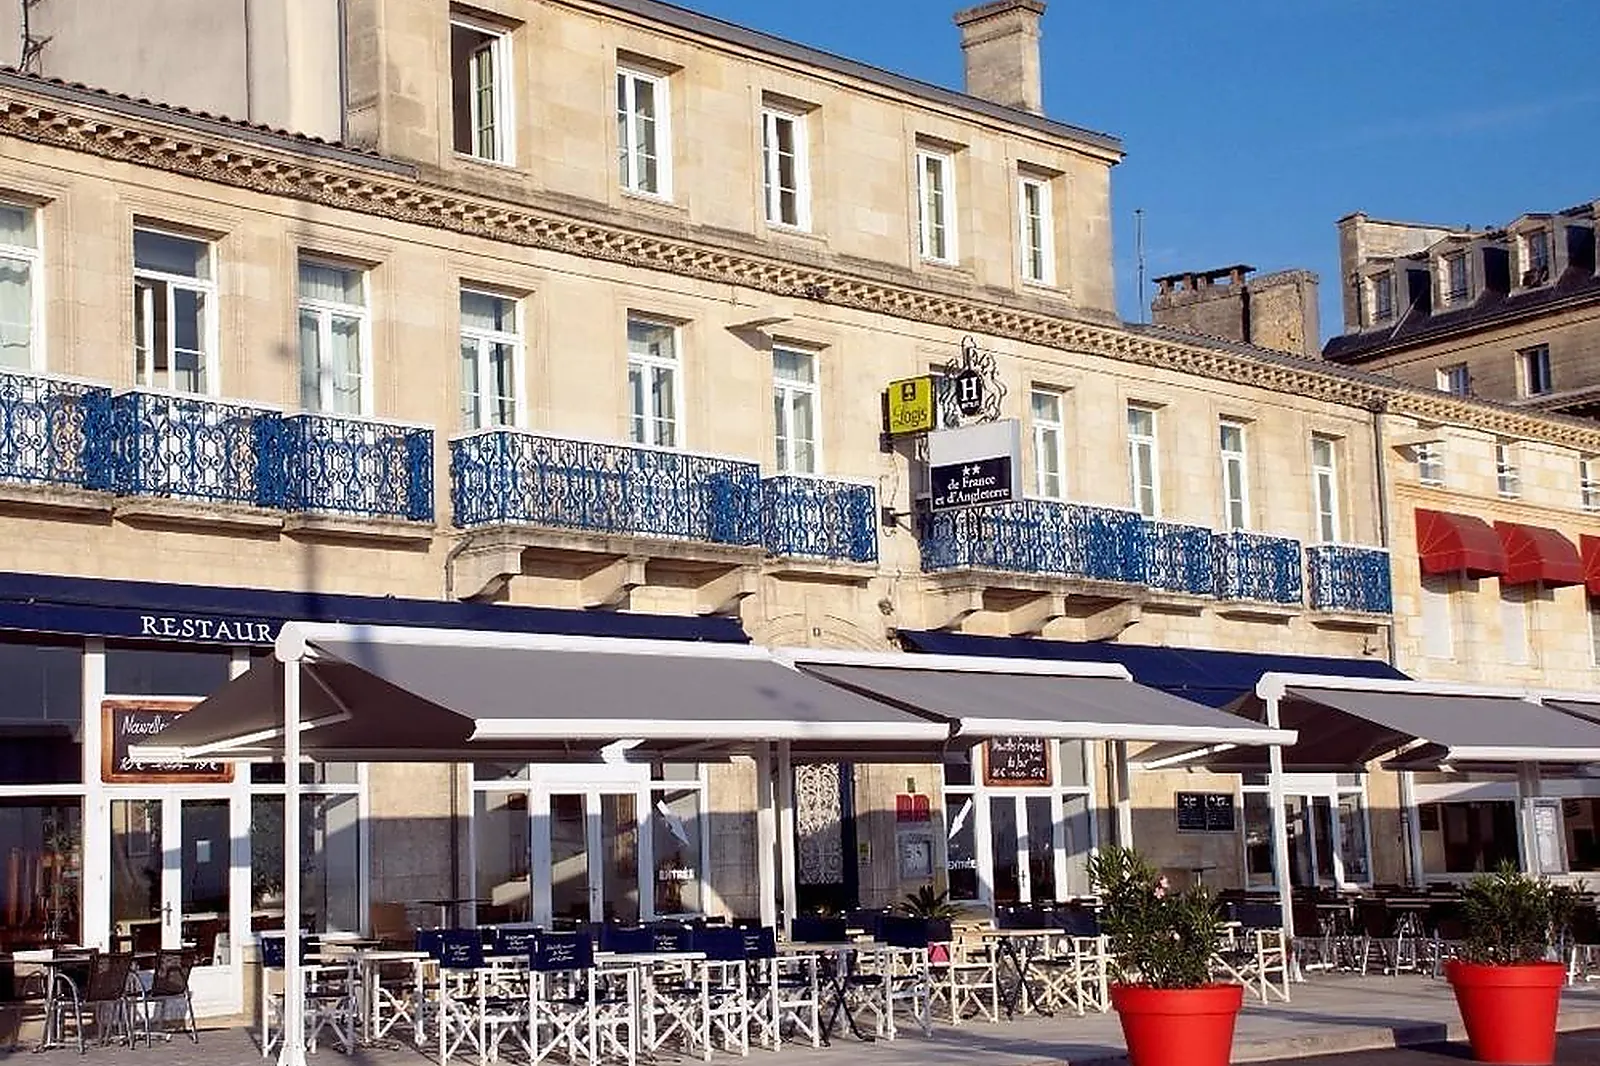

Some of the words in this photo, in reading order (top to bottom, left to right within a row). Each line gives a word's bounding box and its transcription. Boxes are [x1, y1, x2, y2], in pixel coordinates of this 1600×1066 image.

[960, 377, 978, 401] H
[947, 478, 959, 490] de
[962, 476, 996, 488] France
[946, 488, 1010, 506] d'Angleterre
